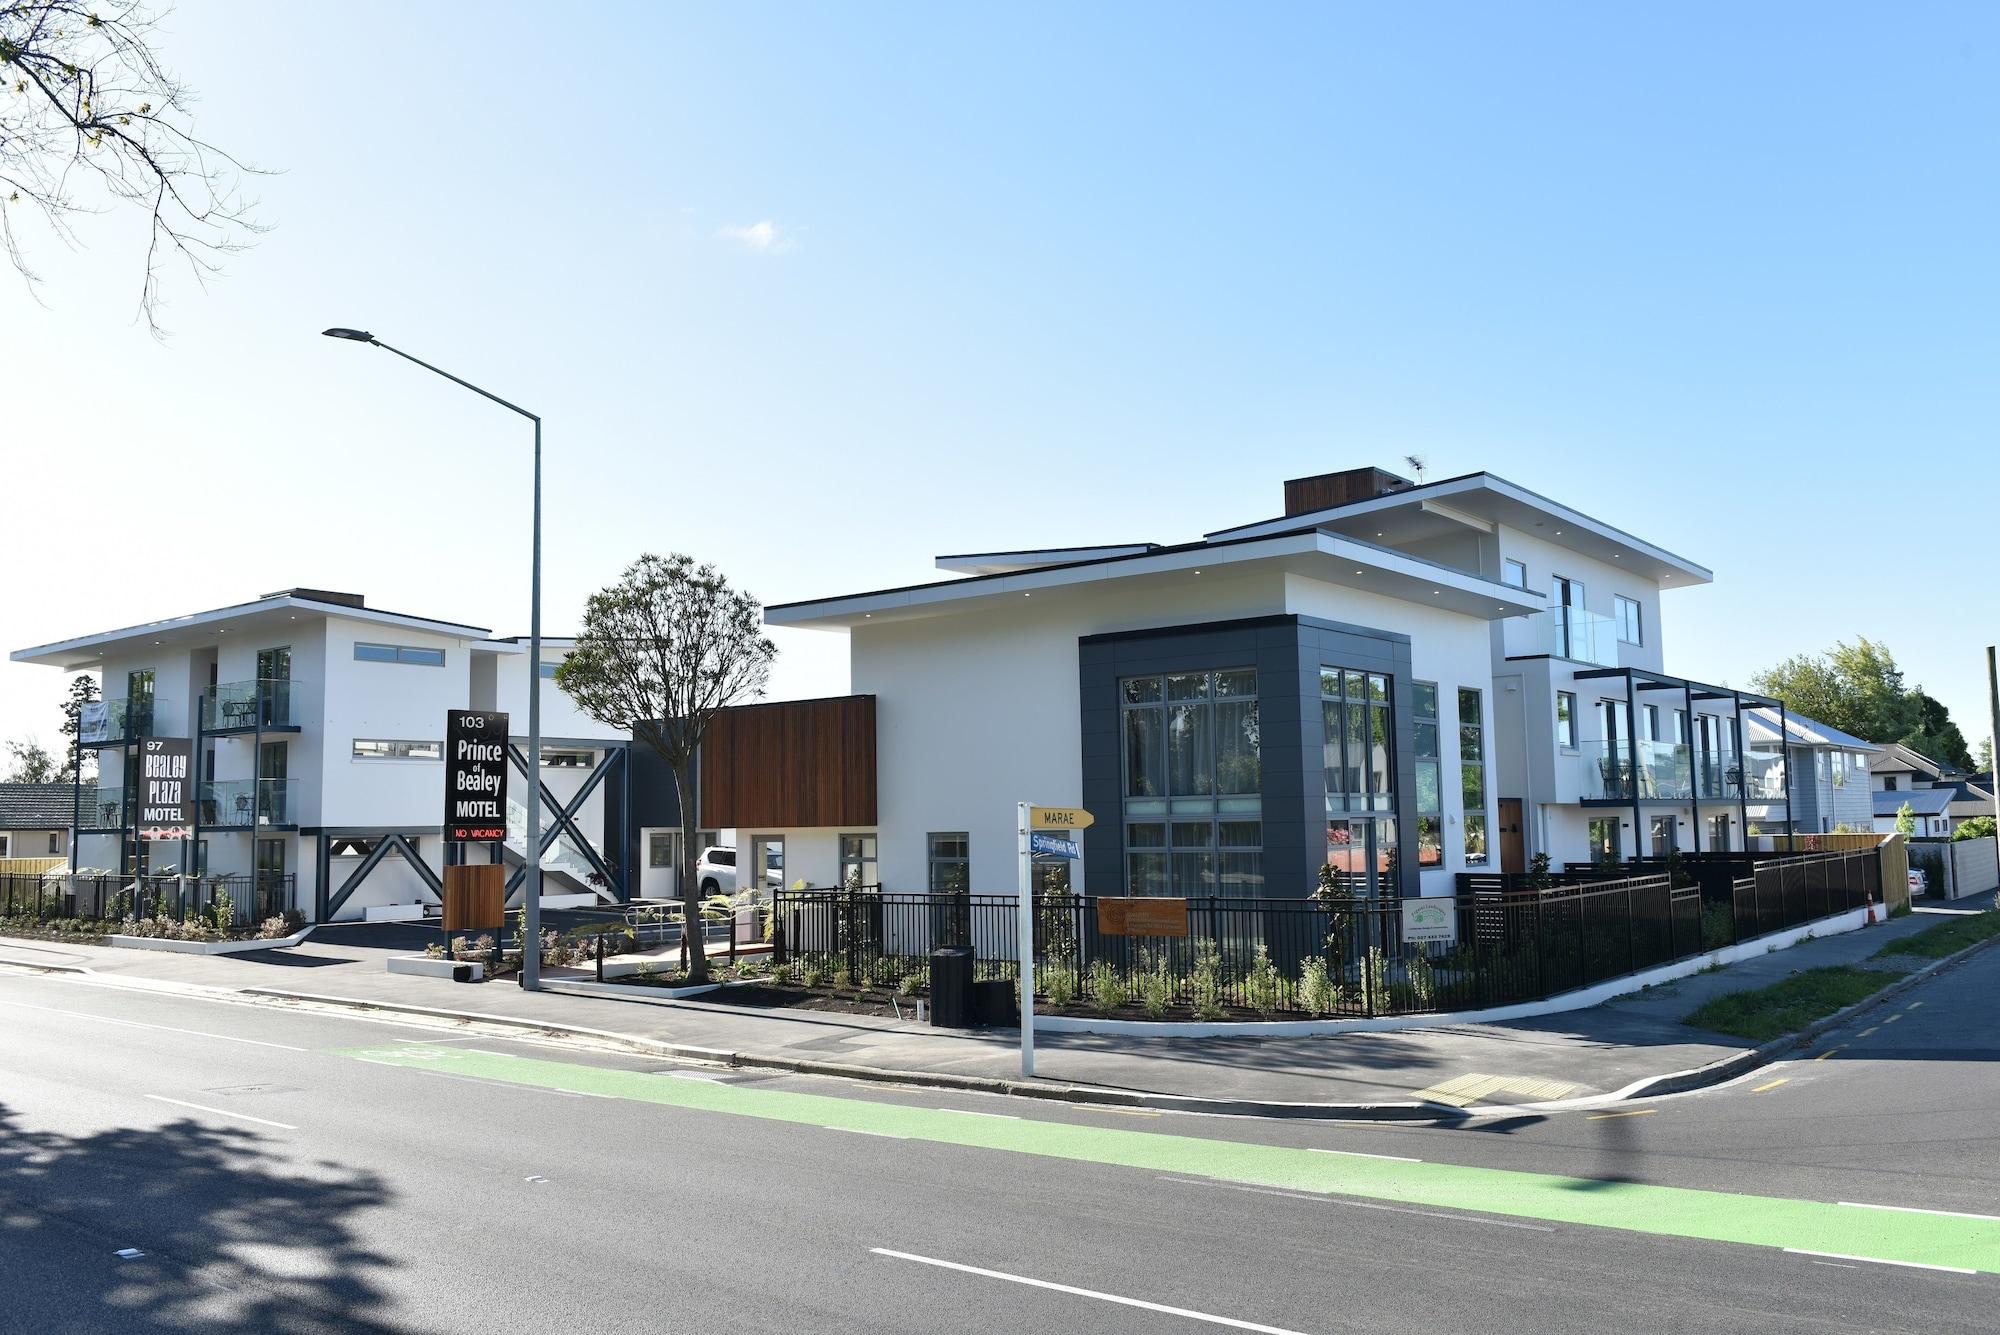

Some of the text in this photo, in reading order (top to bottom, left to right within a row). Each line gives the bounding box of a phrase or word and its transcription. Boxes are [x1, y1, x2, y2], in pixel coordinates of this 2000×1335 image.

[459, 716, 485, 729] 103
[146, 741, 163, 751] 97
[457, 738, 502, 762] Prince
[472, 763, 481, 773] of
[456, 769, 501, 797] Bealey
[143, 808, 185, 821] MOTEL
[456, 800, 500, 818] MOTEL
[1044, 812, 1075, 825] MARAE
[455, 829, 504, 838] NO VACANCY
[1033, 835, 1077, 854] Springfield Rd
